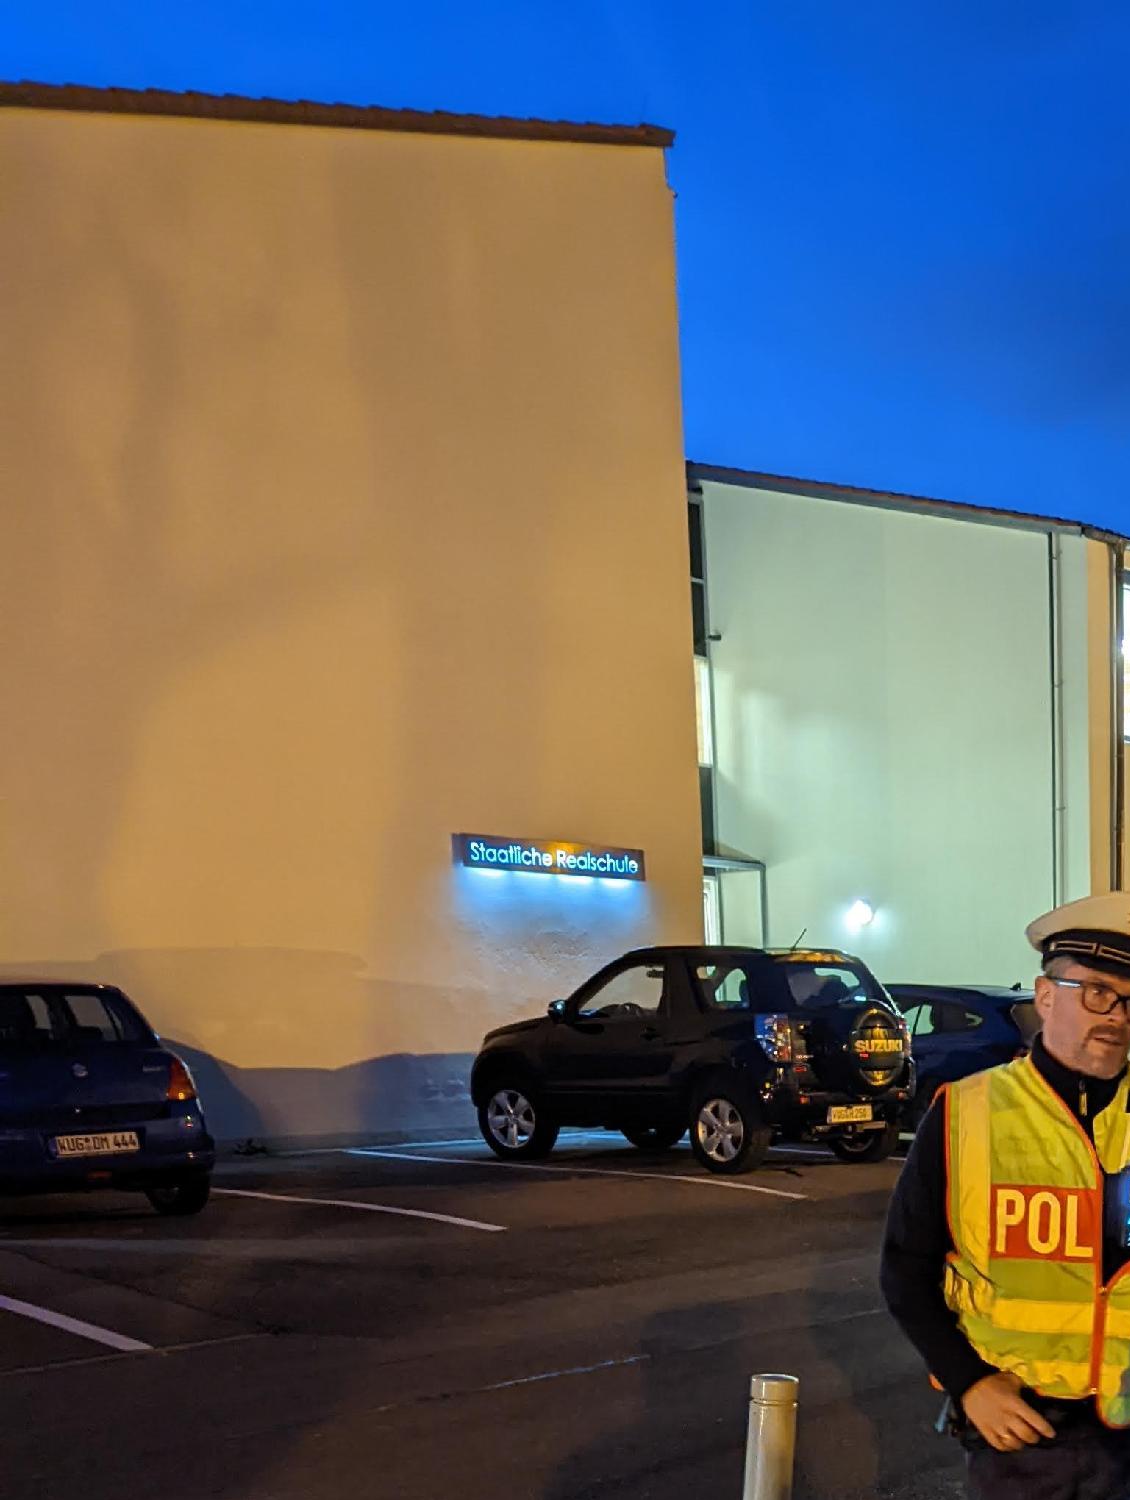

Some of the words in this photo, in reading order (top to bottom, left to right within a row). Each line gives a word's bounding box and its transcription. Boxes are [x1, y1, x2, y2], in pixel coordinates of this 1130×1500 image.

[470, 842, 553, 867] Staatliche
[556, 849, 639, 874] Realschule
[854, 1039, 903, 1053] SUZUKI
[113, 1133, 137, 1149] 444
